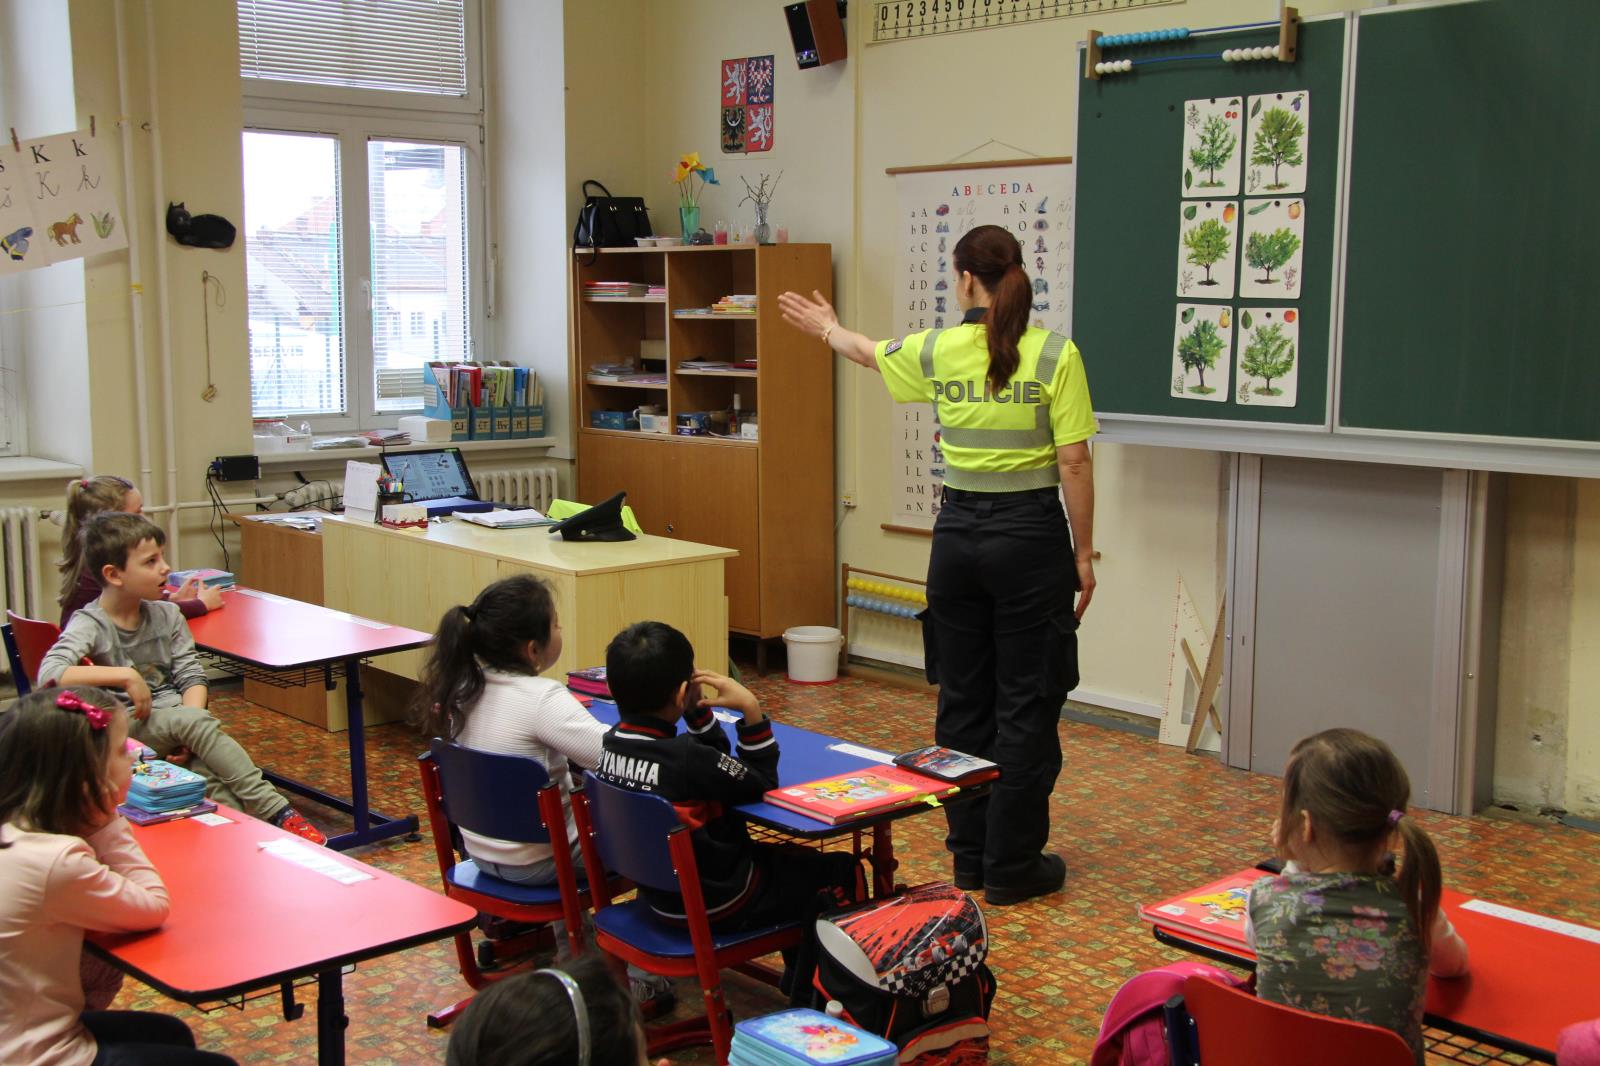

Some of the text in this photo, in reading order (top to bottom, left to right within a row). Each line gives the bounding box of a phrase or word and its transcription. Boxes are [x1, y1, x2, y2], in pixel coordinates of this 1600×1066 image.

[881, 5, 888, 21] 0
[894, 4, 900, 19] 1
[906, 2, 914, 18] 2
[919, 0, 926, 16] 3
[932, 0, 939, 14] 4
[945, 0, 952, 12] 5
[30, 139, 88, 164] K k
[35, 164, 101, 200] K k
[951, 182, 1034, 197] ABECEDA
[920, 208, 928, 218] A
[921, 224, 928, 235] B
[1018, 220, 1027, 232] O
[910, 241, 928, 253] c C
[920, 260, 928, 273] Č
[909, 279, 928, 290] d D
[919, 318, 926, 329] E
[932, 380, 1041, 404] POLICIE
[914, 428, 919, 441] J
[905, 449, 923, 460] k K
[916, 466, 922, 477] L
[916, 484, 925, 495] M
[916, 502, 924, 512] N
[602, 750, 660, 786] YAMAHA
